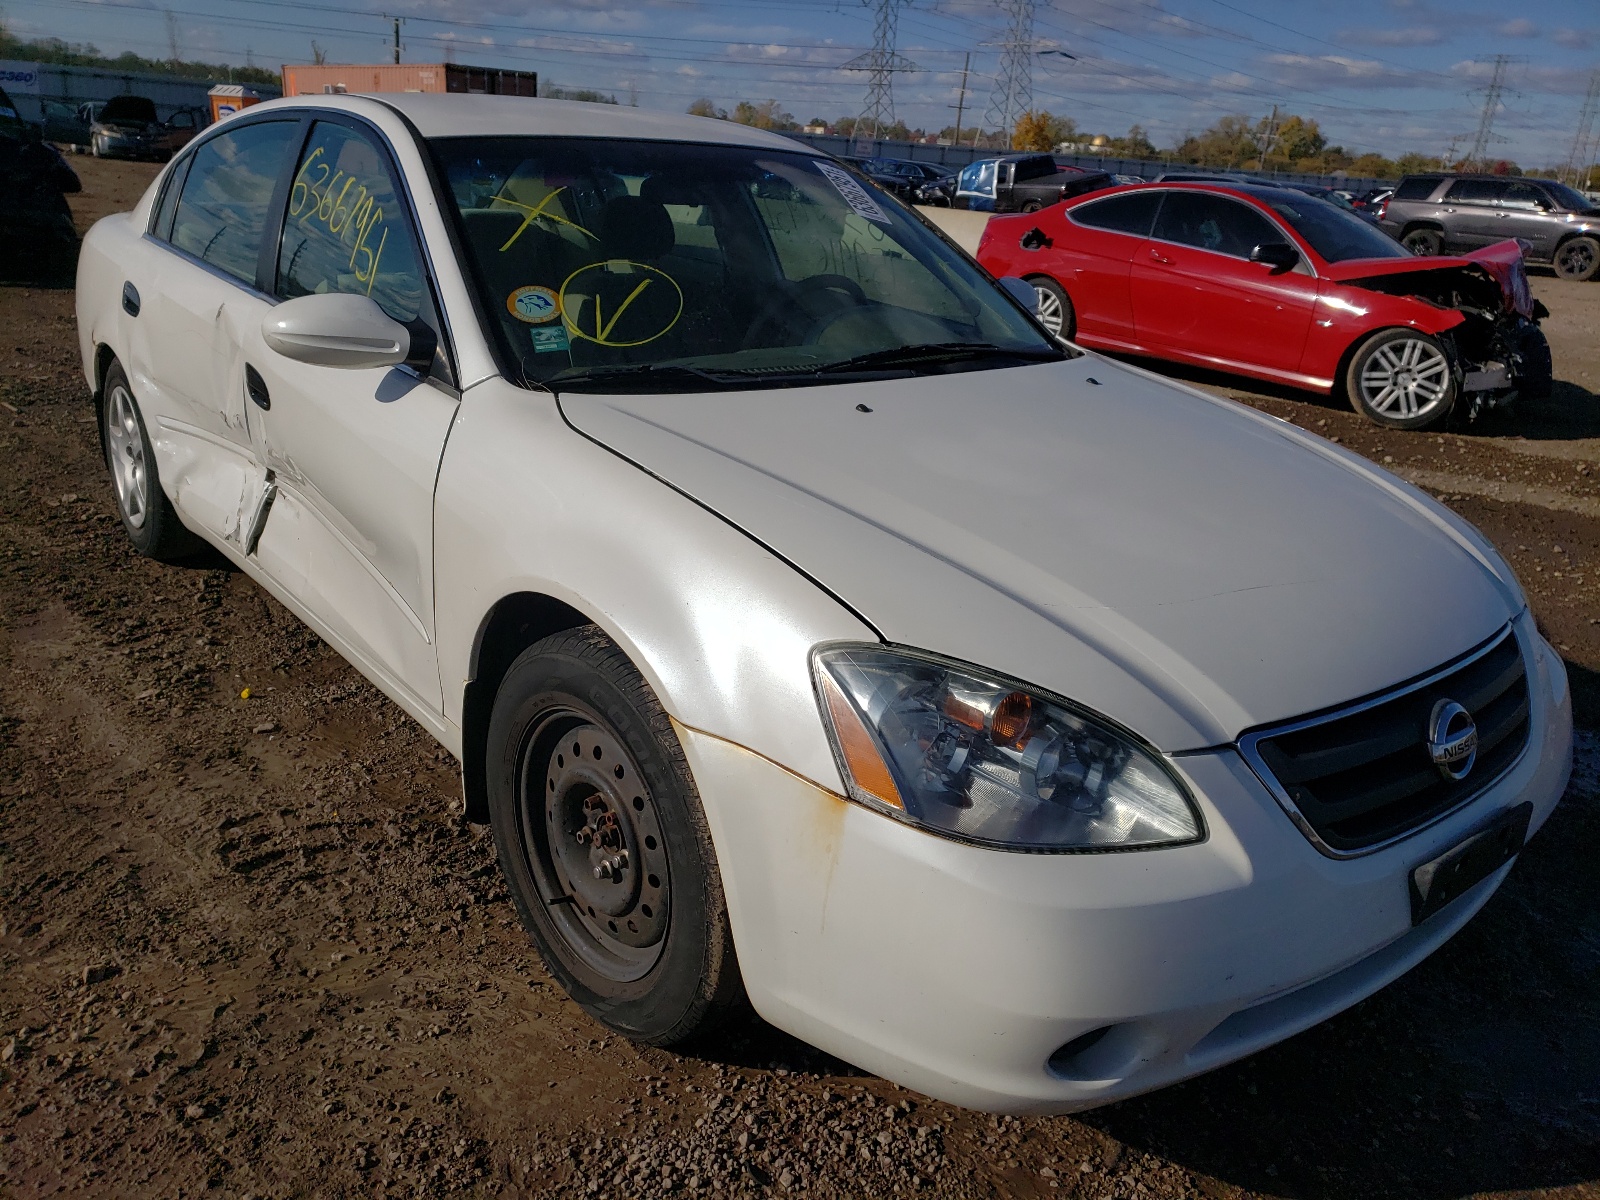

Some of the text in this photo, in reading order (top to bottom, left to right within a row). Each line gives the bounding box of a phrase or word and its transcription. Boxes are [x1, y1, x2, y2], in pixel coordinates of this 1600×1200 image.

[289, 147, 388, 298] 63667951
[515, 286, 554, 296] HOFFMAN
[513, 310, 562, 323] HONOR ROLL
